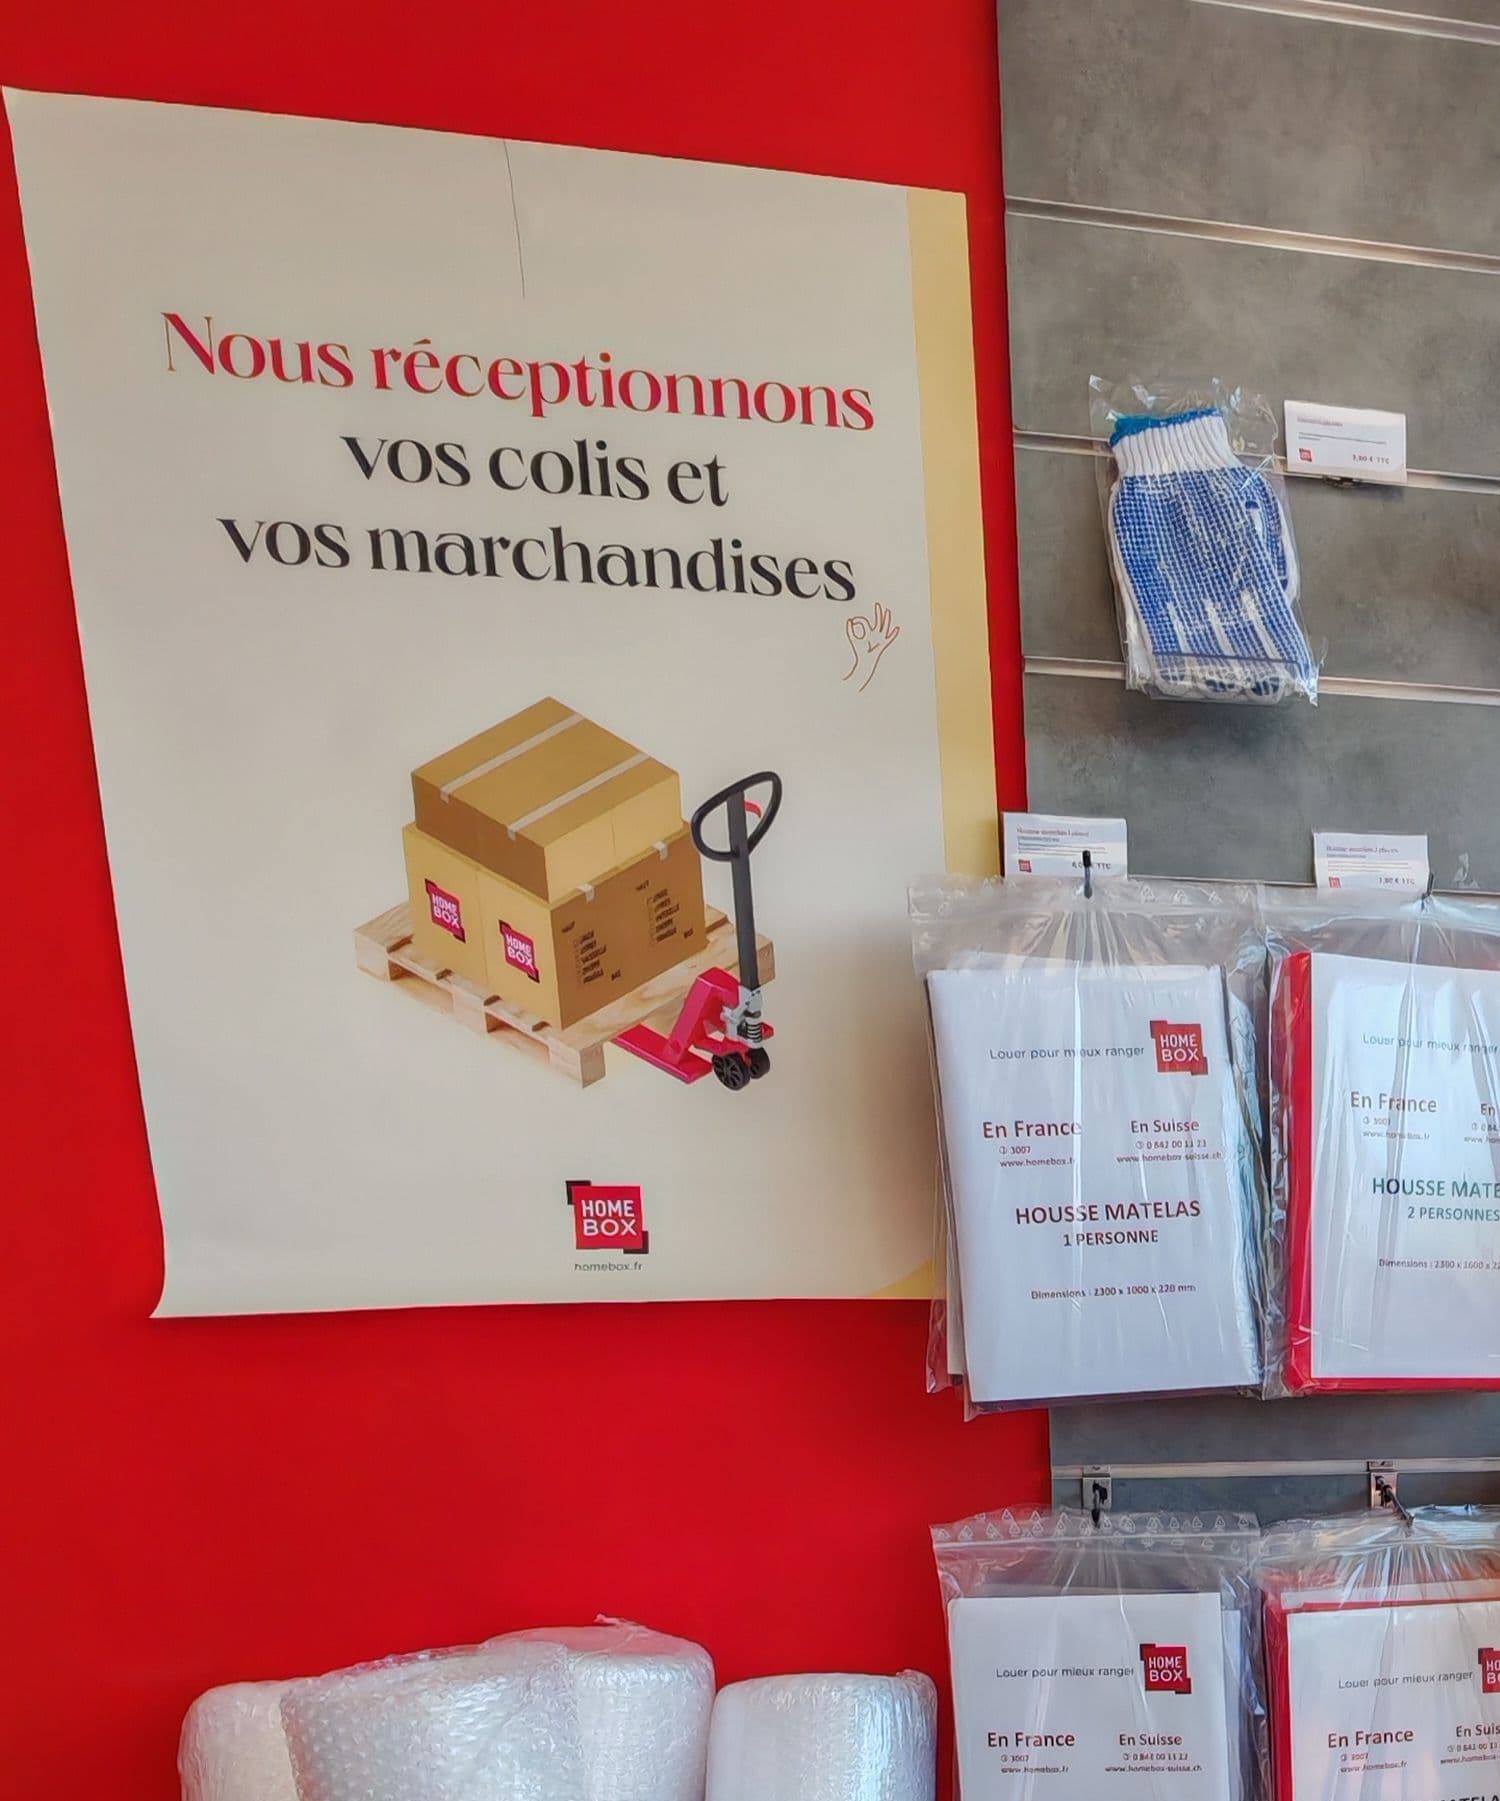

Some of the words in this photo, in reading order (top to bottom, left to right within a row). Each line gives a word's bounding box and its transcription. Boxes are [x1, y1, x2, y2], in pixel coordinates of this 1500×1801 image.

[161, 312, 354, 390] Nous
[372, 340, 875, 431] réceptionnons
[339, 436, 471, 486] vos
[488, 439, 650, 502] colis
[666, 455, 729, 508] et
[218, 517, 350, 567] vos
[367, 524, 857, 602] marchandises
[1160, 1033, 1196, 1047] HOME
[1363, 1033, 1395, 1046] Louer
[1398, 1036, 1423, 1050] pour
[1427, 1039, 1460, 1050] mieux
[990, 1048, 1026, 1059] Louer
[1030, 1047, 1059, 1059] pour
[1105, 1045, 1144, 1059] ranger
[1162, 1049, 1199, 1062] BOX
[1351, 1092, 1371, 1109] En
[1379, 1094, 1437, 1112] France
[1480, 1103, 1495, 1116] En
[983, 1121, 1007, 1138] En
[1015, 1120, 1081, 1137] France
[1131, 1121, 1148, 1133] En
[1153, 1119, 1199, 1132] Suisse
[1373, 1177, 1445, 1196] HOUSSE
[582, 1199, 634, 1217] HOME
[1016, 1205, 1099, 1224] HOUSSE
[1105, 1200, 1200, 1220] MATELAS
[1408, 1206, 1414, 1218] 2
[1420, 1207, 1500, 1221] PERSONNES
[583, 1218, 637, 1236] BOX
[1063, 1234, 1071, 1246] 1
[1076, 1230, 1159, 1245] PERSONNE
[574, 1260, 642, 1272] homebox.fr
[1379, 1259, 1427, 1268] Dimensions
[1149, 1656, 1182, 1669] HOME
[996, 1667, 1028, 1678] Louer
[1031, 1668, 1058, 1678] pour
[1062, 1667, 1095, 1677] mieux
[1099, 1666, 1134, 1678] ranger
[1149, 1669, 1183, 1682] BOX
[1338, 1678, 1369, 1689] Louer
[1374, 1676, 1400, 1688] pour
[1403, 1672, 1435, 1684] mieux
[1438, 1670, 1474, 1683] ranger
[988, 1732, 1008, 1747] En
[1015, 1732, 1075, 1747] France
[1119, 1734, 1135, 1745] En
[1139, 1733, 1182, 1746] Suisse
[1328, 1733, 1349, 1748] En
[1355, 1729, 1414, 1747] France
[1456, 1726, 1471, 1738] En
